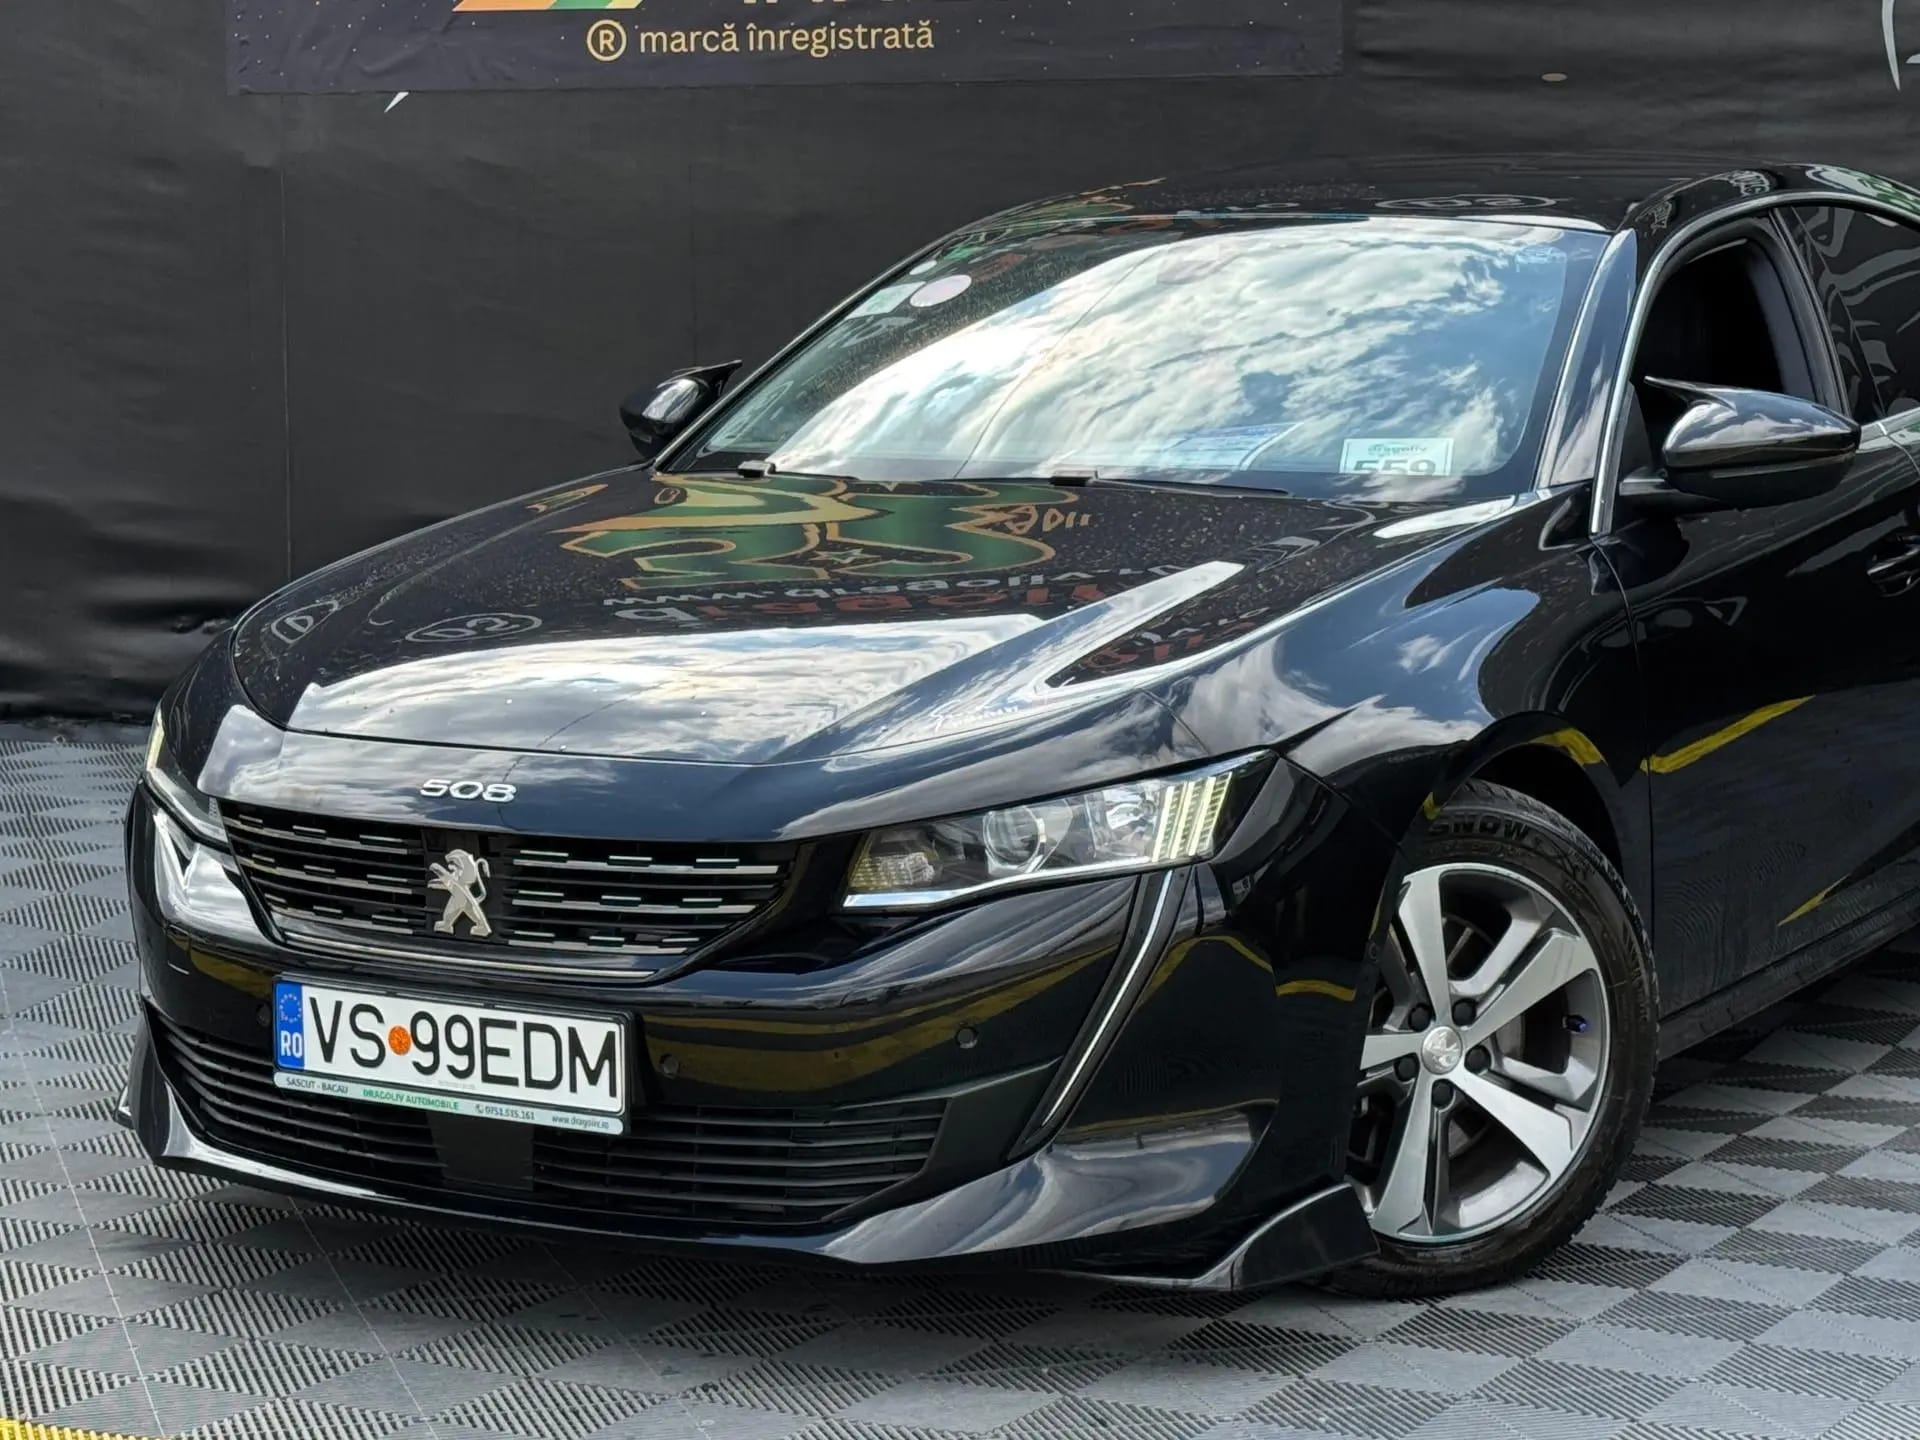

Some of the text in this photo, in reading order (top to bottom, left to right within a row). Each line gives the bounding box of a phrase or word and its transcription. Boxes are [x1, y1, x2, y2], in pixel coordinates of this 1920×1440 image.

[639, 24, 739, 53] marcă
[747, 18, 934, 59] înregistrată
[419, 779, 517, 803] 508
[279, 1030, 303, 1059] RO
[309, 997, 618, 1098] VS 99EDM
[286, 1077, 316, 1091] SASCUT
[362, 1088, 405, 1104] DRAGOLIV
[406, 1095, 459, 1111] AUTOMOBILE
